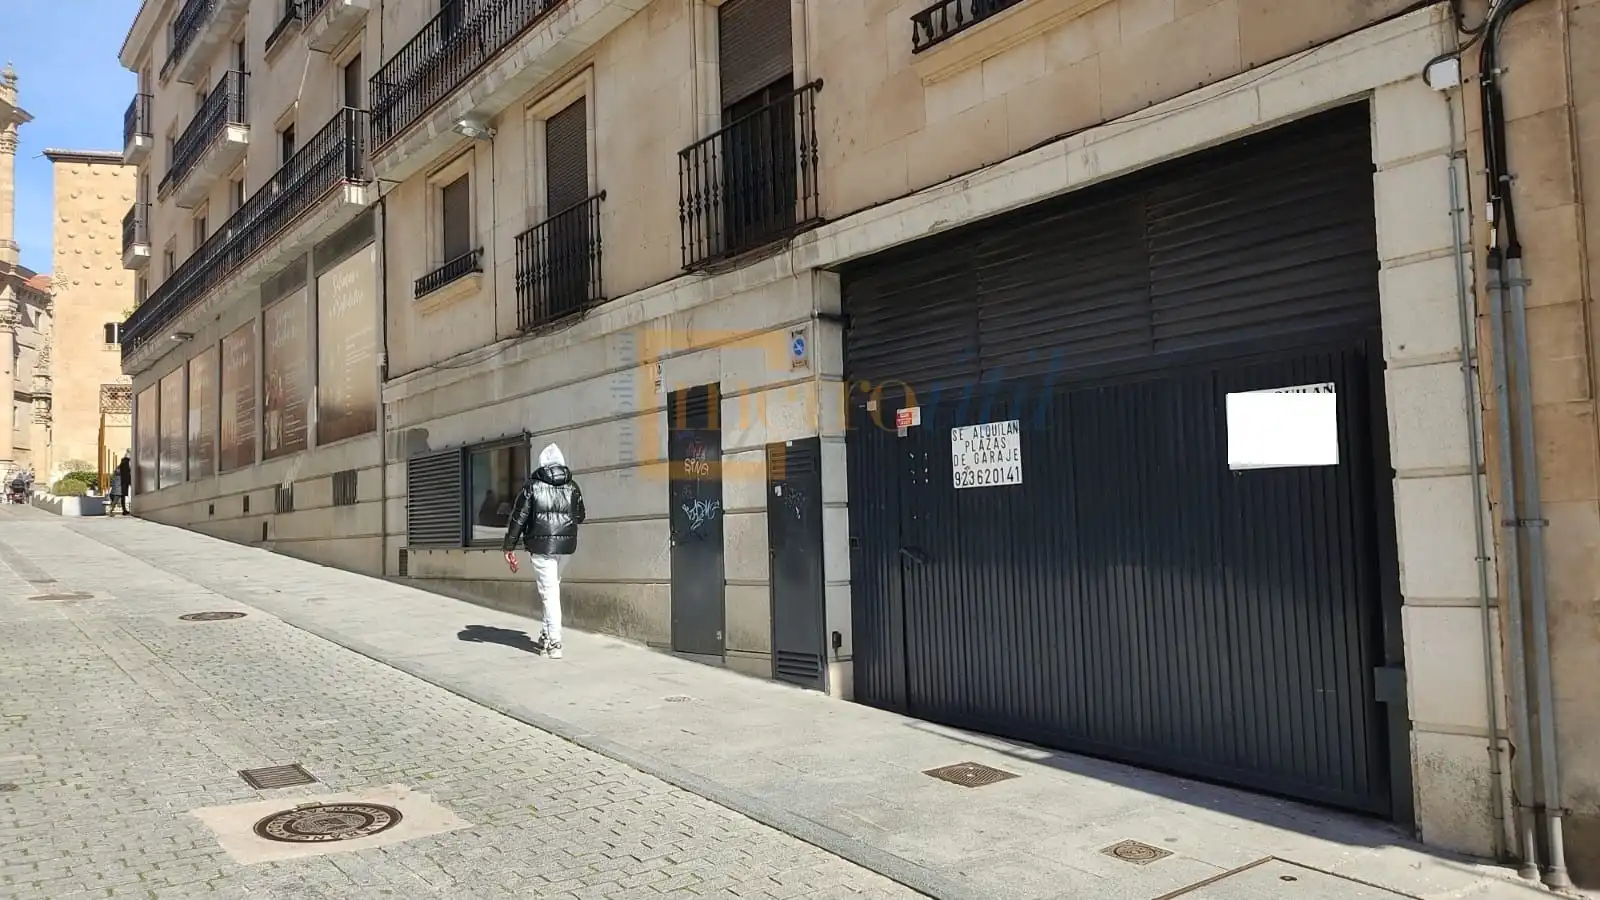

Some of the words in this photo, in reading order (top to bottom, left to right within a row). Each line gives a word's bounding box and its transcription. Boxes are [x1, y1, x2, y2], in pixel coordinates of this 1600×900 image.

[953, 430, 964, 442] SE
[973, 421, 1019, 438] ALQUILAN
[965, 437, 1006, 453] PLAZAS
[953, 454, 966, 467] DE
[974, 448, 1018, 464] GARAJE
[955, 466, 1020, 486] 923620141
